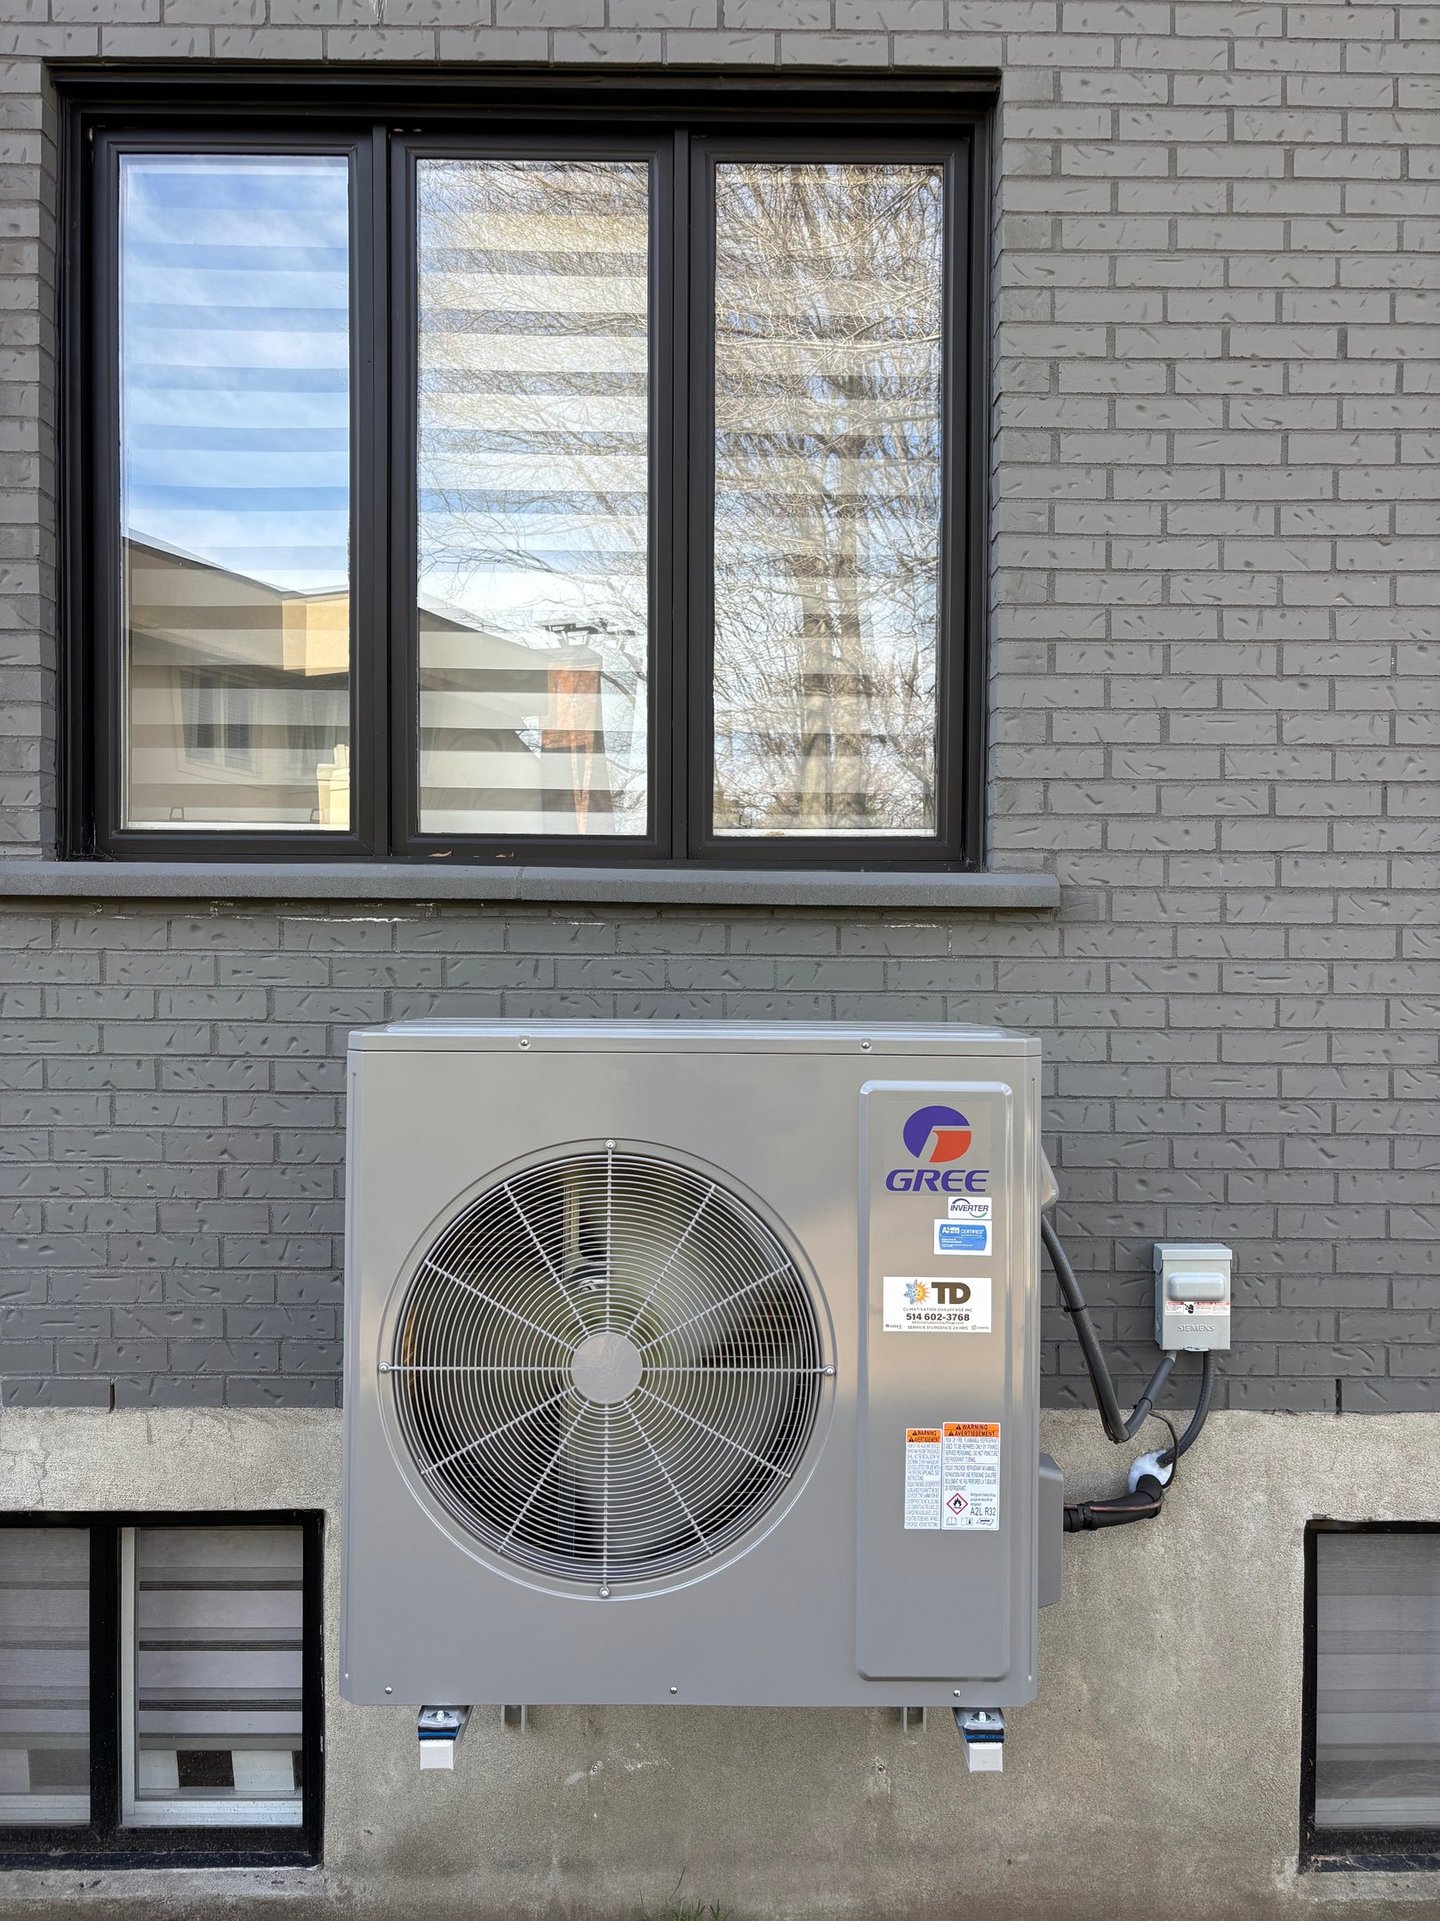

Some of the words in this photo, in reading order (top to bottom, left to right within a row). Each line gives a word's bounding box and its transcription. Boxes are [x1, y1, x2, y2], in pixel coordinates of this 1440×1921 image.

[885, 1169, 990, 1192] GREE
[950, 1204, 989, 1212] INVERTER
[931, 1282, 971, 1305] TD
[924, 1313, 970, 1321] 602-3768
[1177, 1323, 1215, 1332] SIEMENS
[970, 1506, 983, 1516] A2L
[984, 1507, 996, 1516] R32
